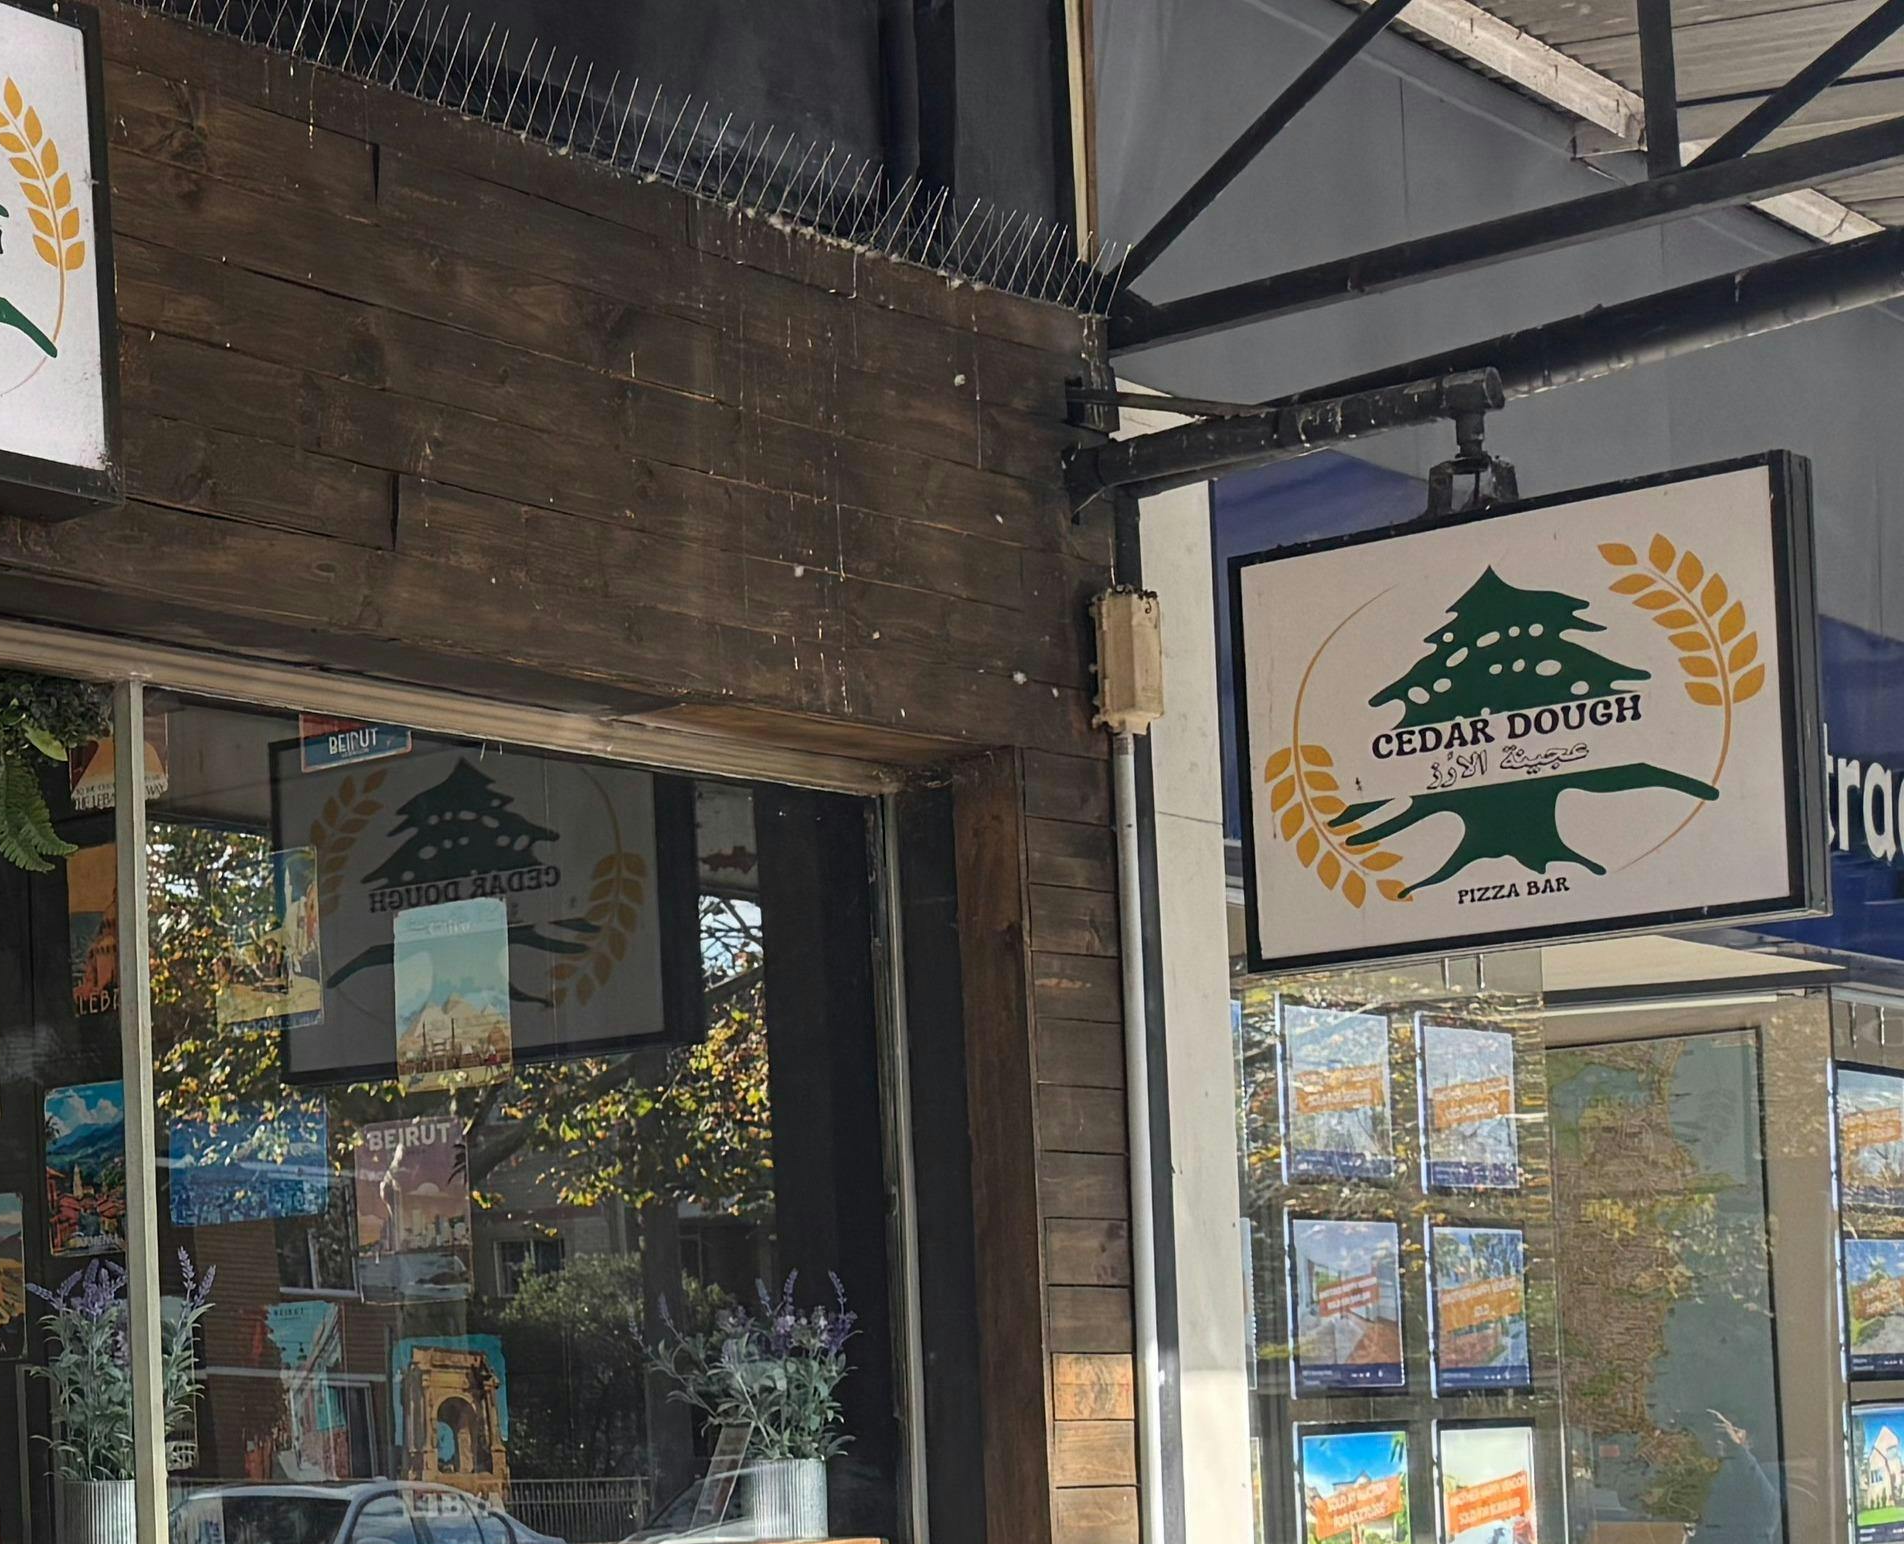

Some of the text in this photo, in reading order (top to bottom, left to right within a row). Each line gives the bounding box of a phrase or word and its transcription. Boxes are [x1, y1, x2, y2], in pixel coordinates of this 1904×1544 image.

[328, 727, 379, 755] BEIRUT
[1372, 694, 1642, 760] CEDAR DOUGH
[1458, 876, 1571, 905] PIZZA BAR
[367, 1122, 451, 1151] BEIRUT
